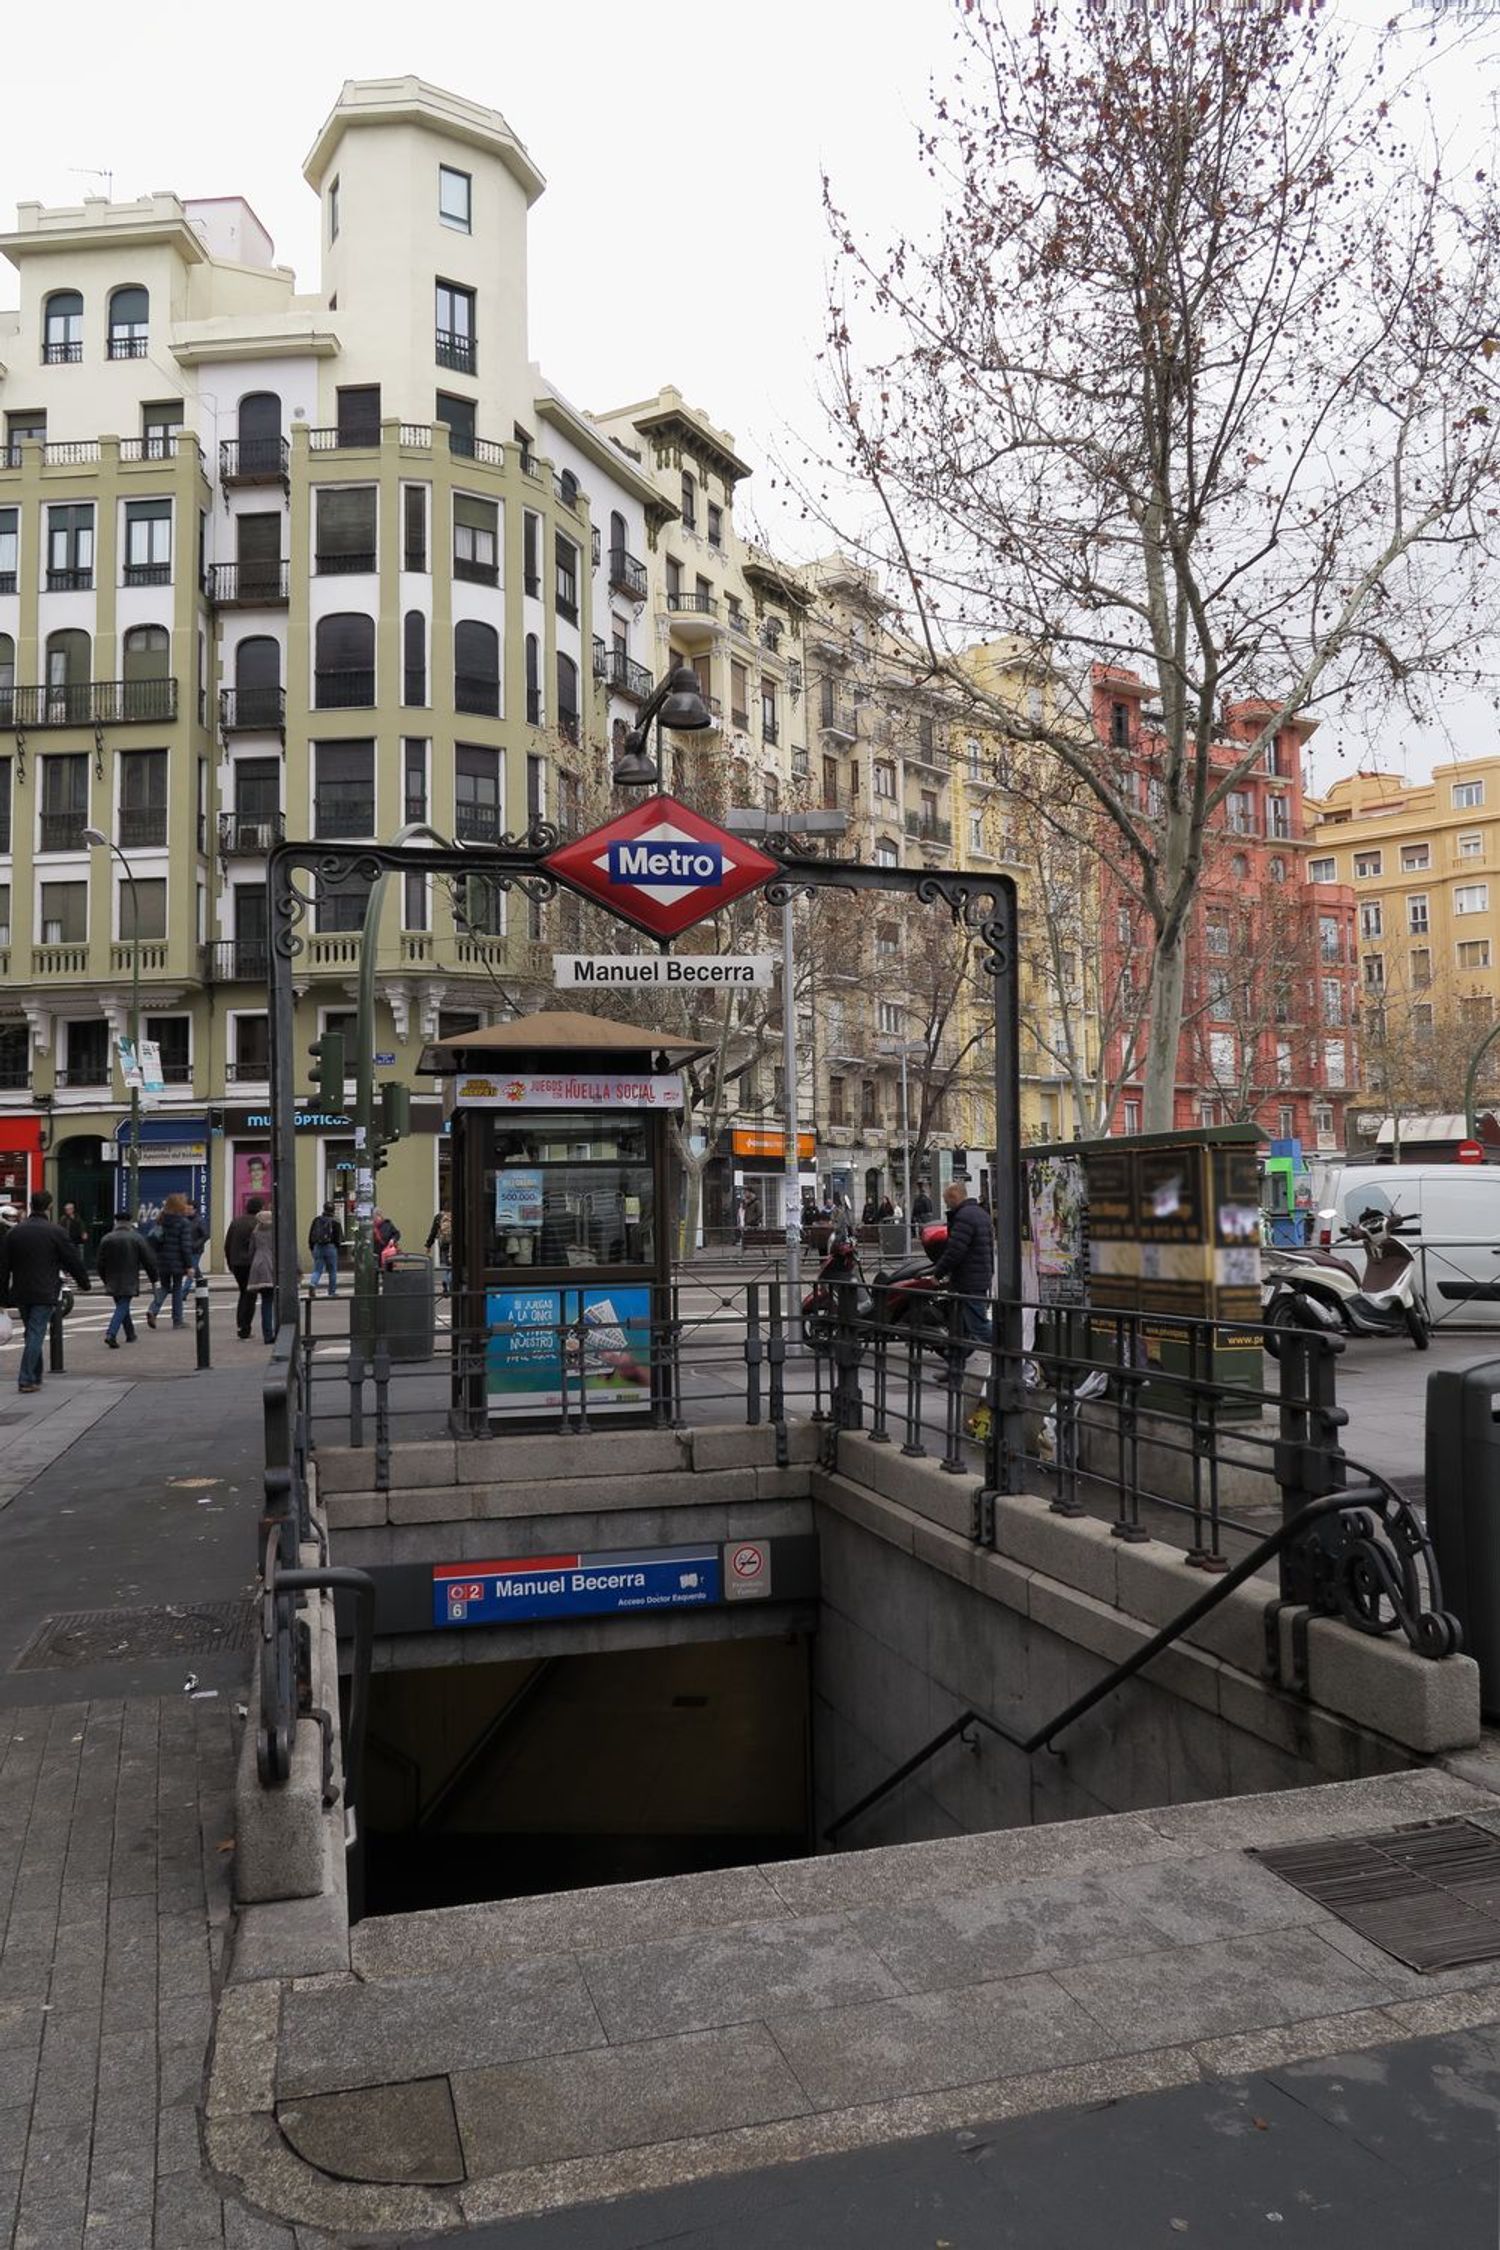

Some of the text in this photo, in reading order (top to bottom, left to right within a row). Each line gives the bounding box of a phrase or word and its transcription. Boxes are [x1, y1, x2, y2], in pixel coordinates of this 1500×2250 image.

[619, 847, 714, 876] Metro
[574, 960, 755, 981] Manuel Becerra
[530, 1080, 563, 1091] JUEGOS
[565, 1079, 610, 1099] HUELLA
[616, 1083, 656, 1103] SOCIAL
[469, 1573, 646, 1599] 2 Manuel Becerra
[452, 1604, 463, 1617] 6
[646, 1595, 671, 1604] Doctor
